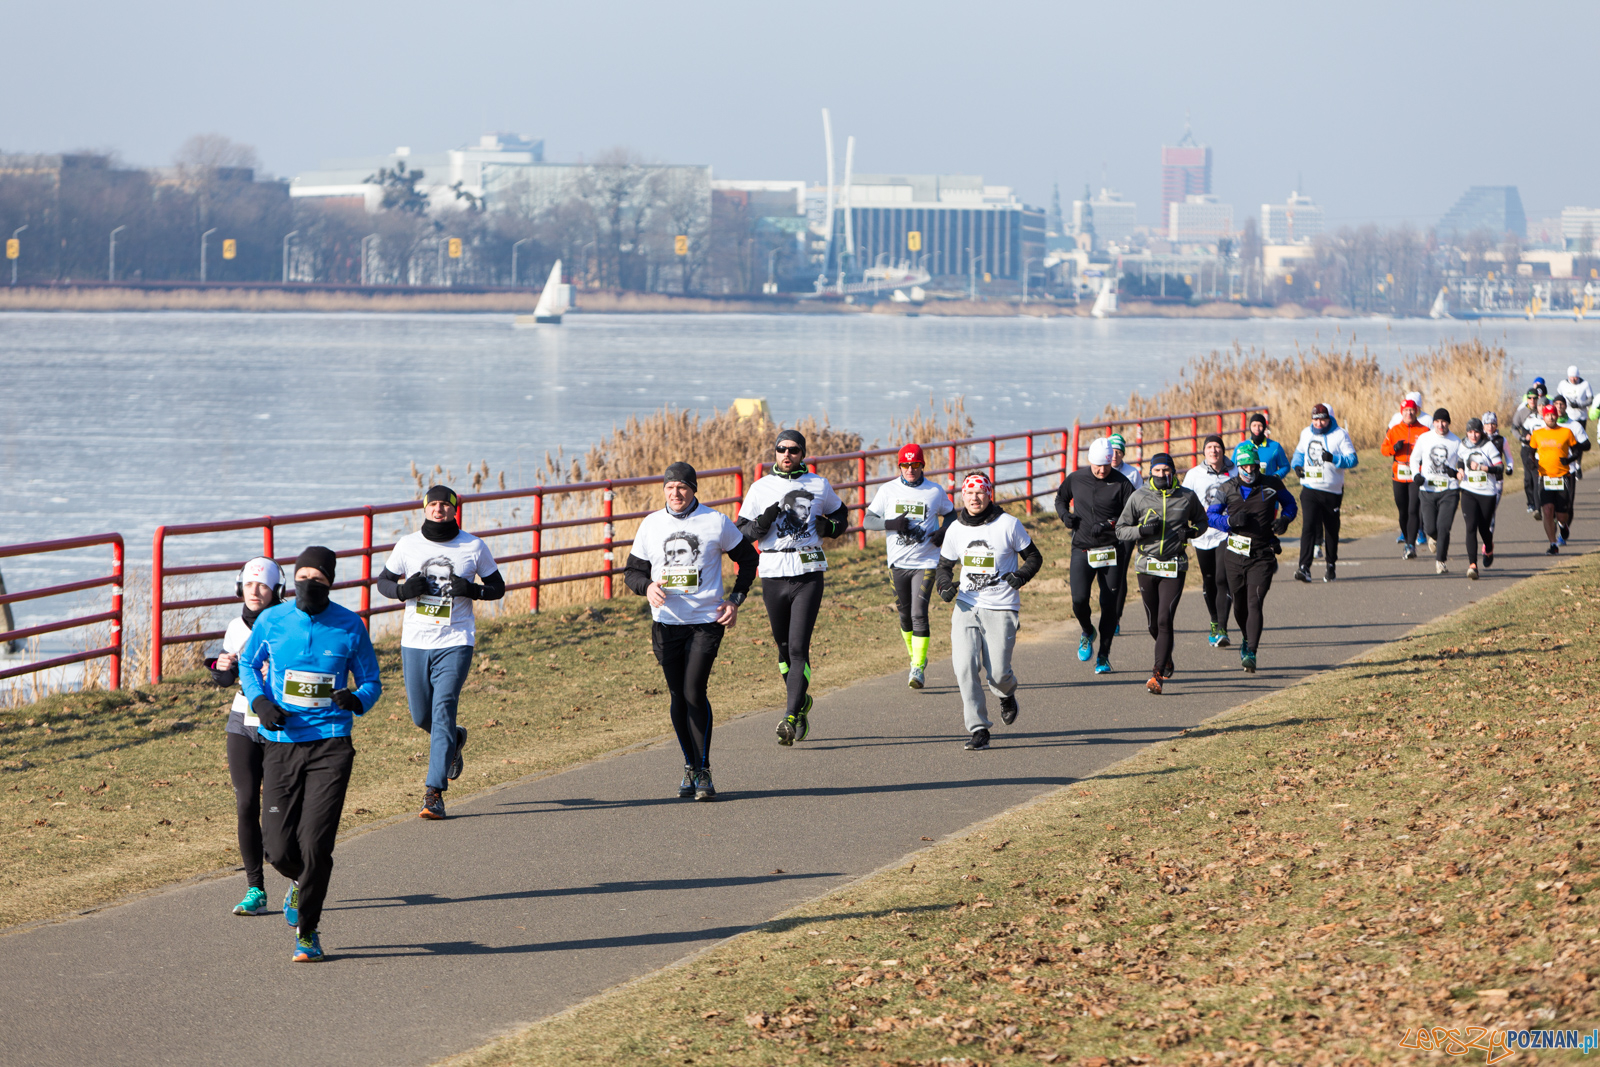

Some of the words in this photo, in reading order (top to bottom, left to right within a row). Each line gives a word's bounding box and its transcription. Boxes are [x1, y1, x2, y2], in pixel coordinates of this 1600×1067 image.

[903, 505, 916, 513] 312
[971, 556, 985, 565] 467
[1155, 562, 1169, 570] 614
[671, 575, 688, 584] 223
[424, 604, 440, 614] 737
[297, 682, 319, 694] 231
